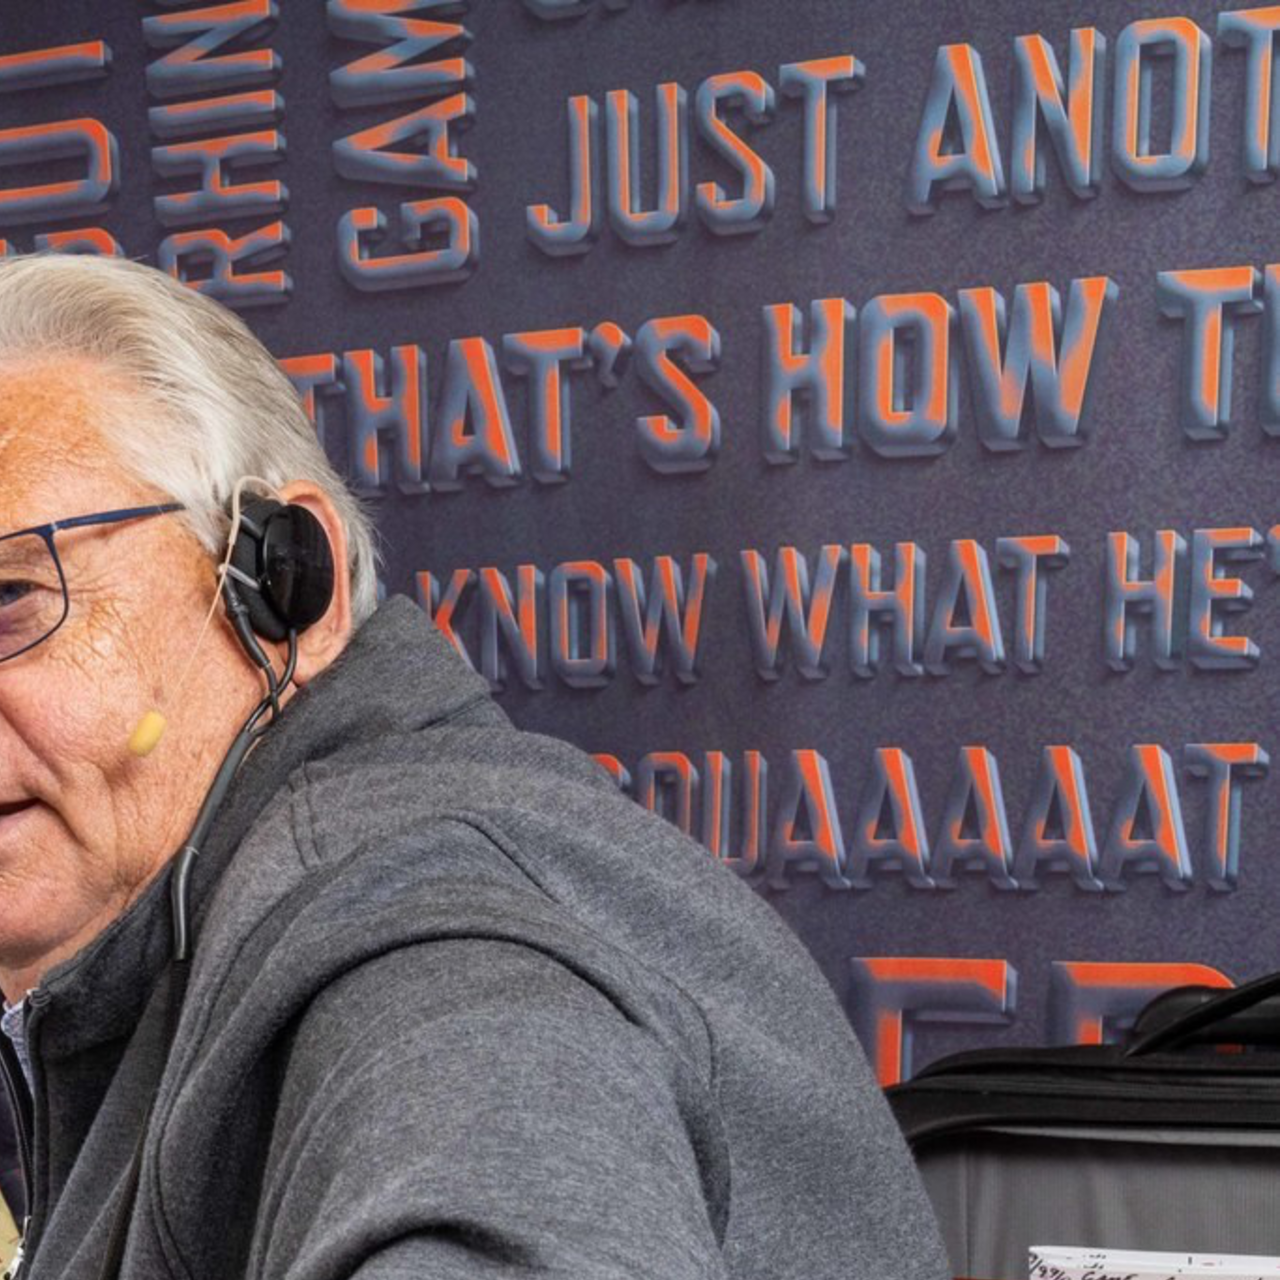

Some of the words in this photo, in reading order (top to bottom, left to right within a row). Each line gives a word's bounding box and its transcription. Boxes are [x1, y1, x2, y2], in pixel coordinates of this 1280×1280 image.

[526, 55, 864, 250] JUST
[908, 6, 1280, 213] ANOT
[278, 314, 722, 490] THAT'S
[762, 276, 1118, 465] HOW
[414, 552, 714, 690] KNOW
[740, 535, 1070, 680] WHAT
